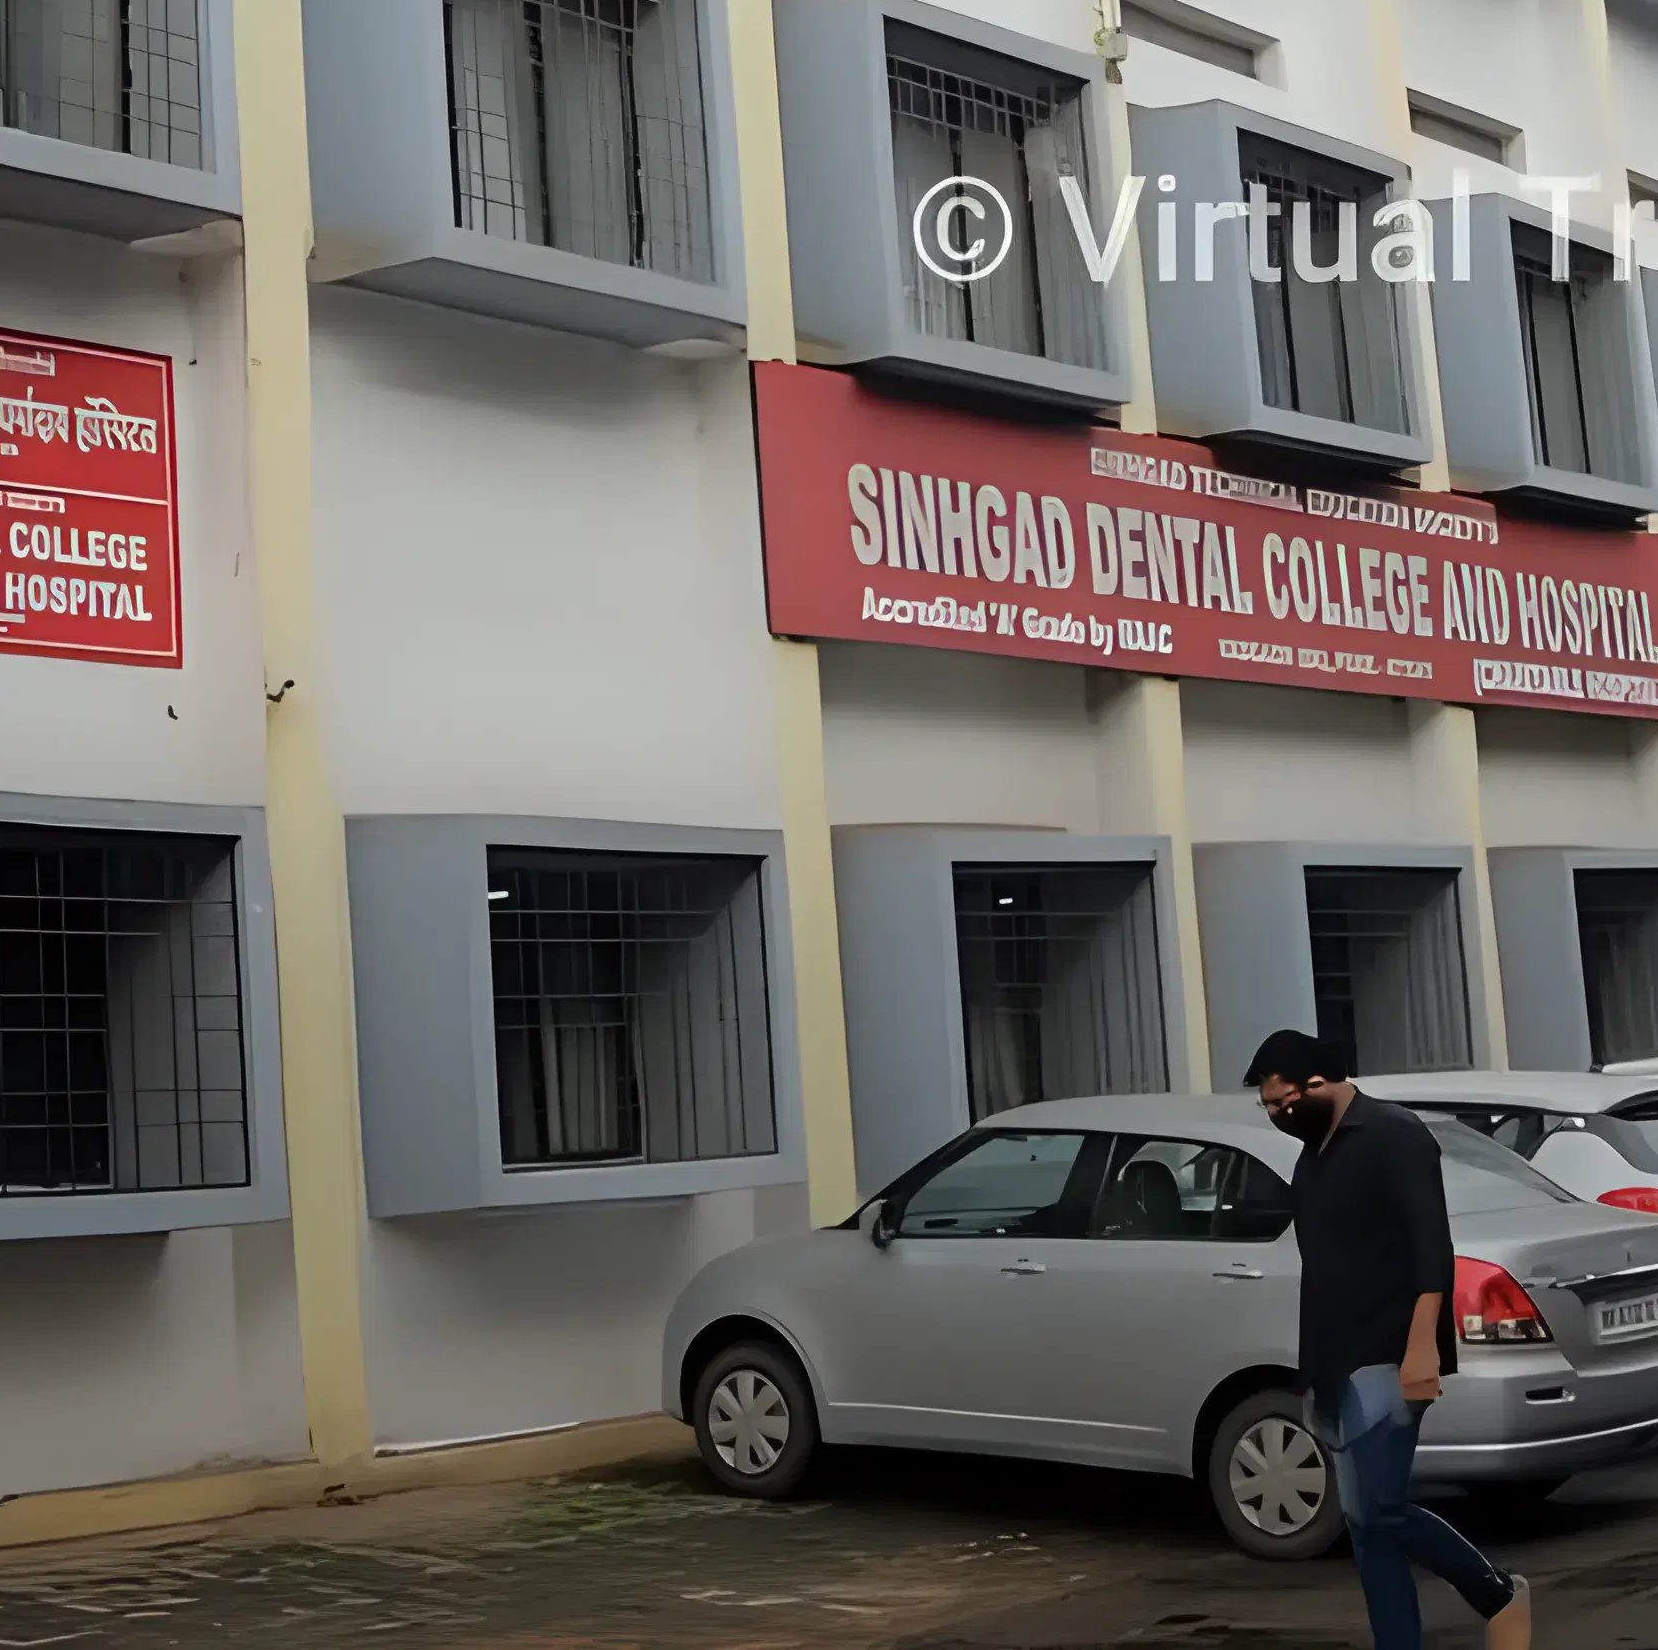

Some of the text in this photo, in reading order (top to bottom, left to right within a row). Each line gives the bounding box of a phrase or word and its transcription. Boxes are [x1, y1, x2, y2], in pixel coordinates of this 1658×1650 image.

[9, 521, 148, 572] COLLEGE
[847, 462, 1076, 590] SINHGAD
[1086, 502, 1253, 615] DENTAL
[1262, 531, 1434, 638] COLLEGE
[1443, 559, 1510, 646] AND
[5, 571, 153, 622] HOSPITAL
[1088, 614, 1113, 656] by
